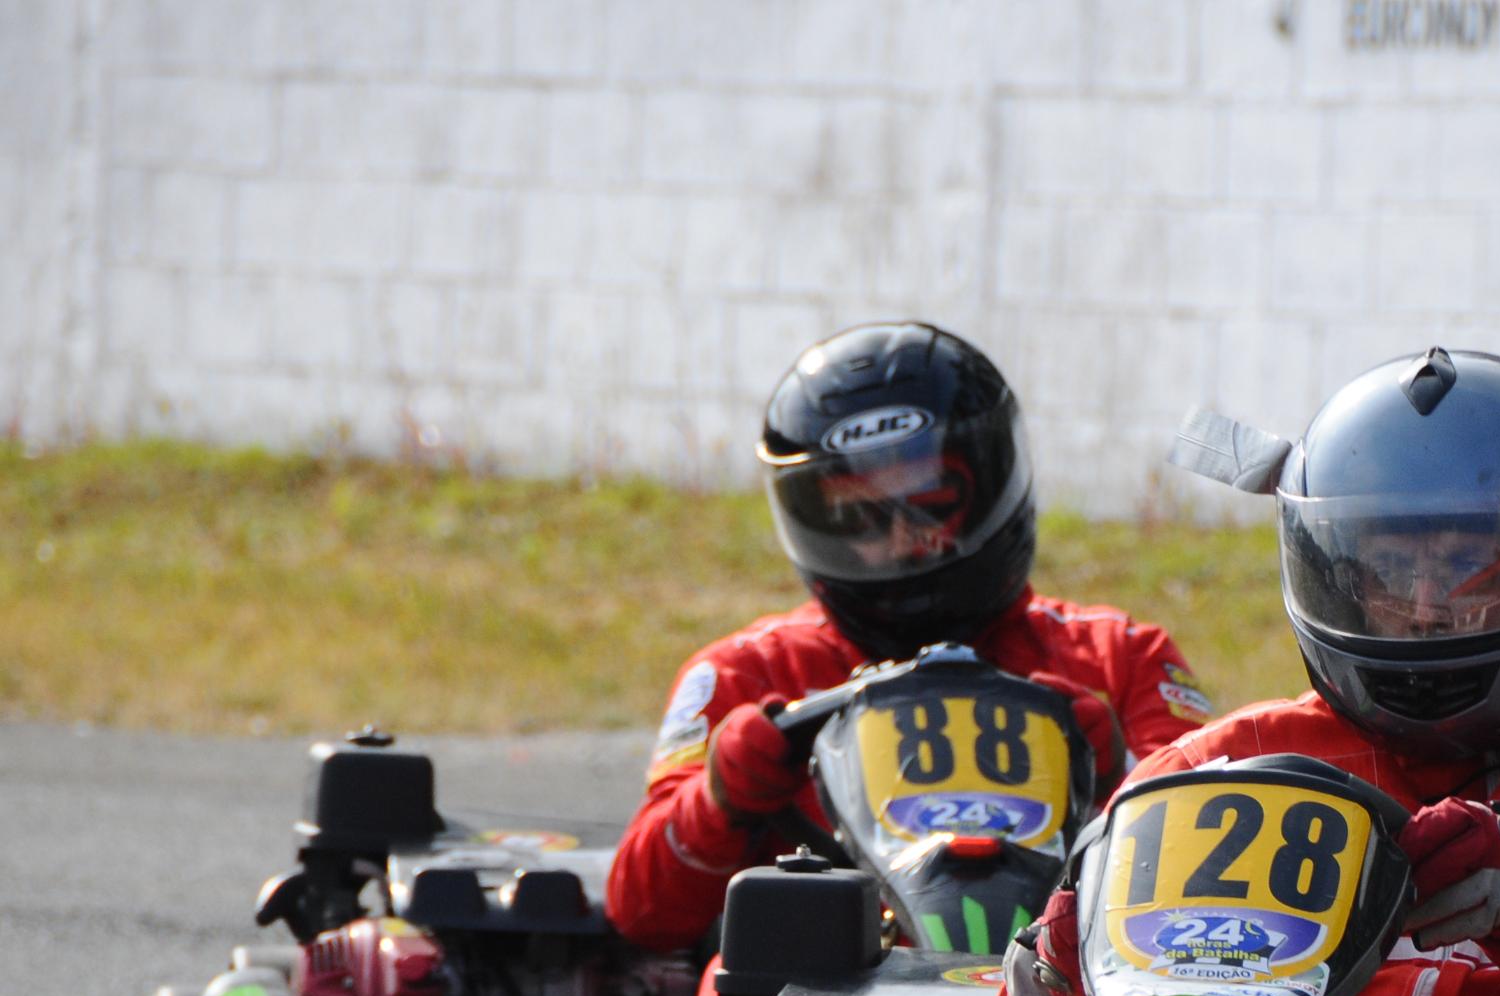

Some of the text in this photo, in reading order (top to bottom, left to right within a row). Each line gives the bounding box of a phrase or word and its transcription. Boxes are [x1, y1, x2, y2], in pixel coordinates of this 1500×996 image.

[895, 697, 1031, 787] 88
[929, 801, 988, 826] 24
[1119, 793, 1349, 913] 128
[1171, 918, 1244, 946] 24
[1165, 947, 1260, 961] da Batalha
[1197, 967, 1252, 979] EDIÇÃO
